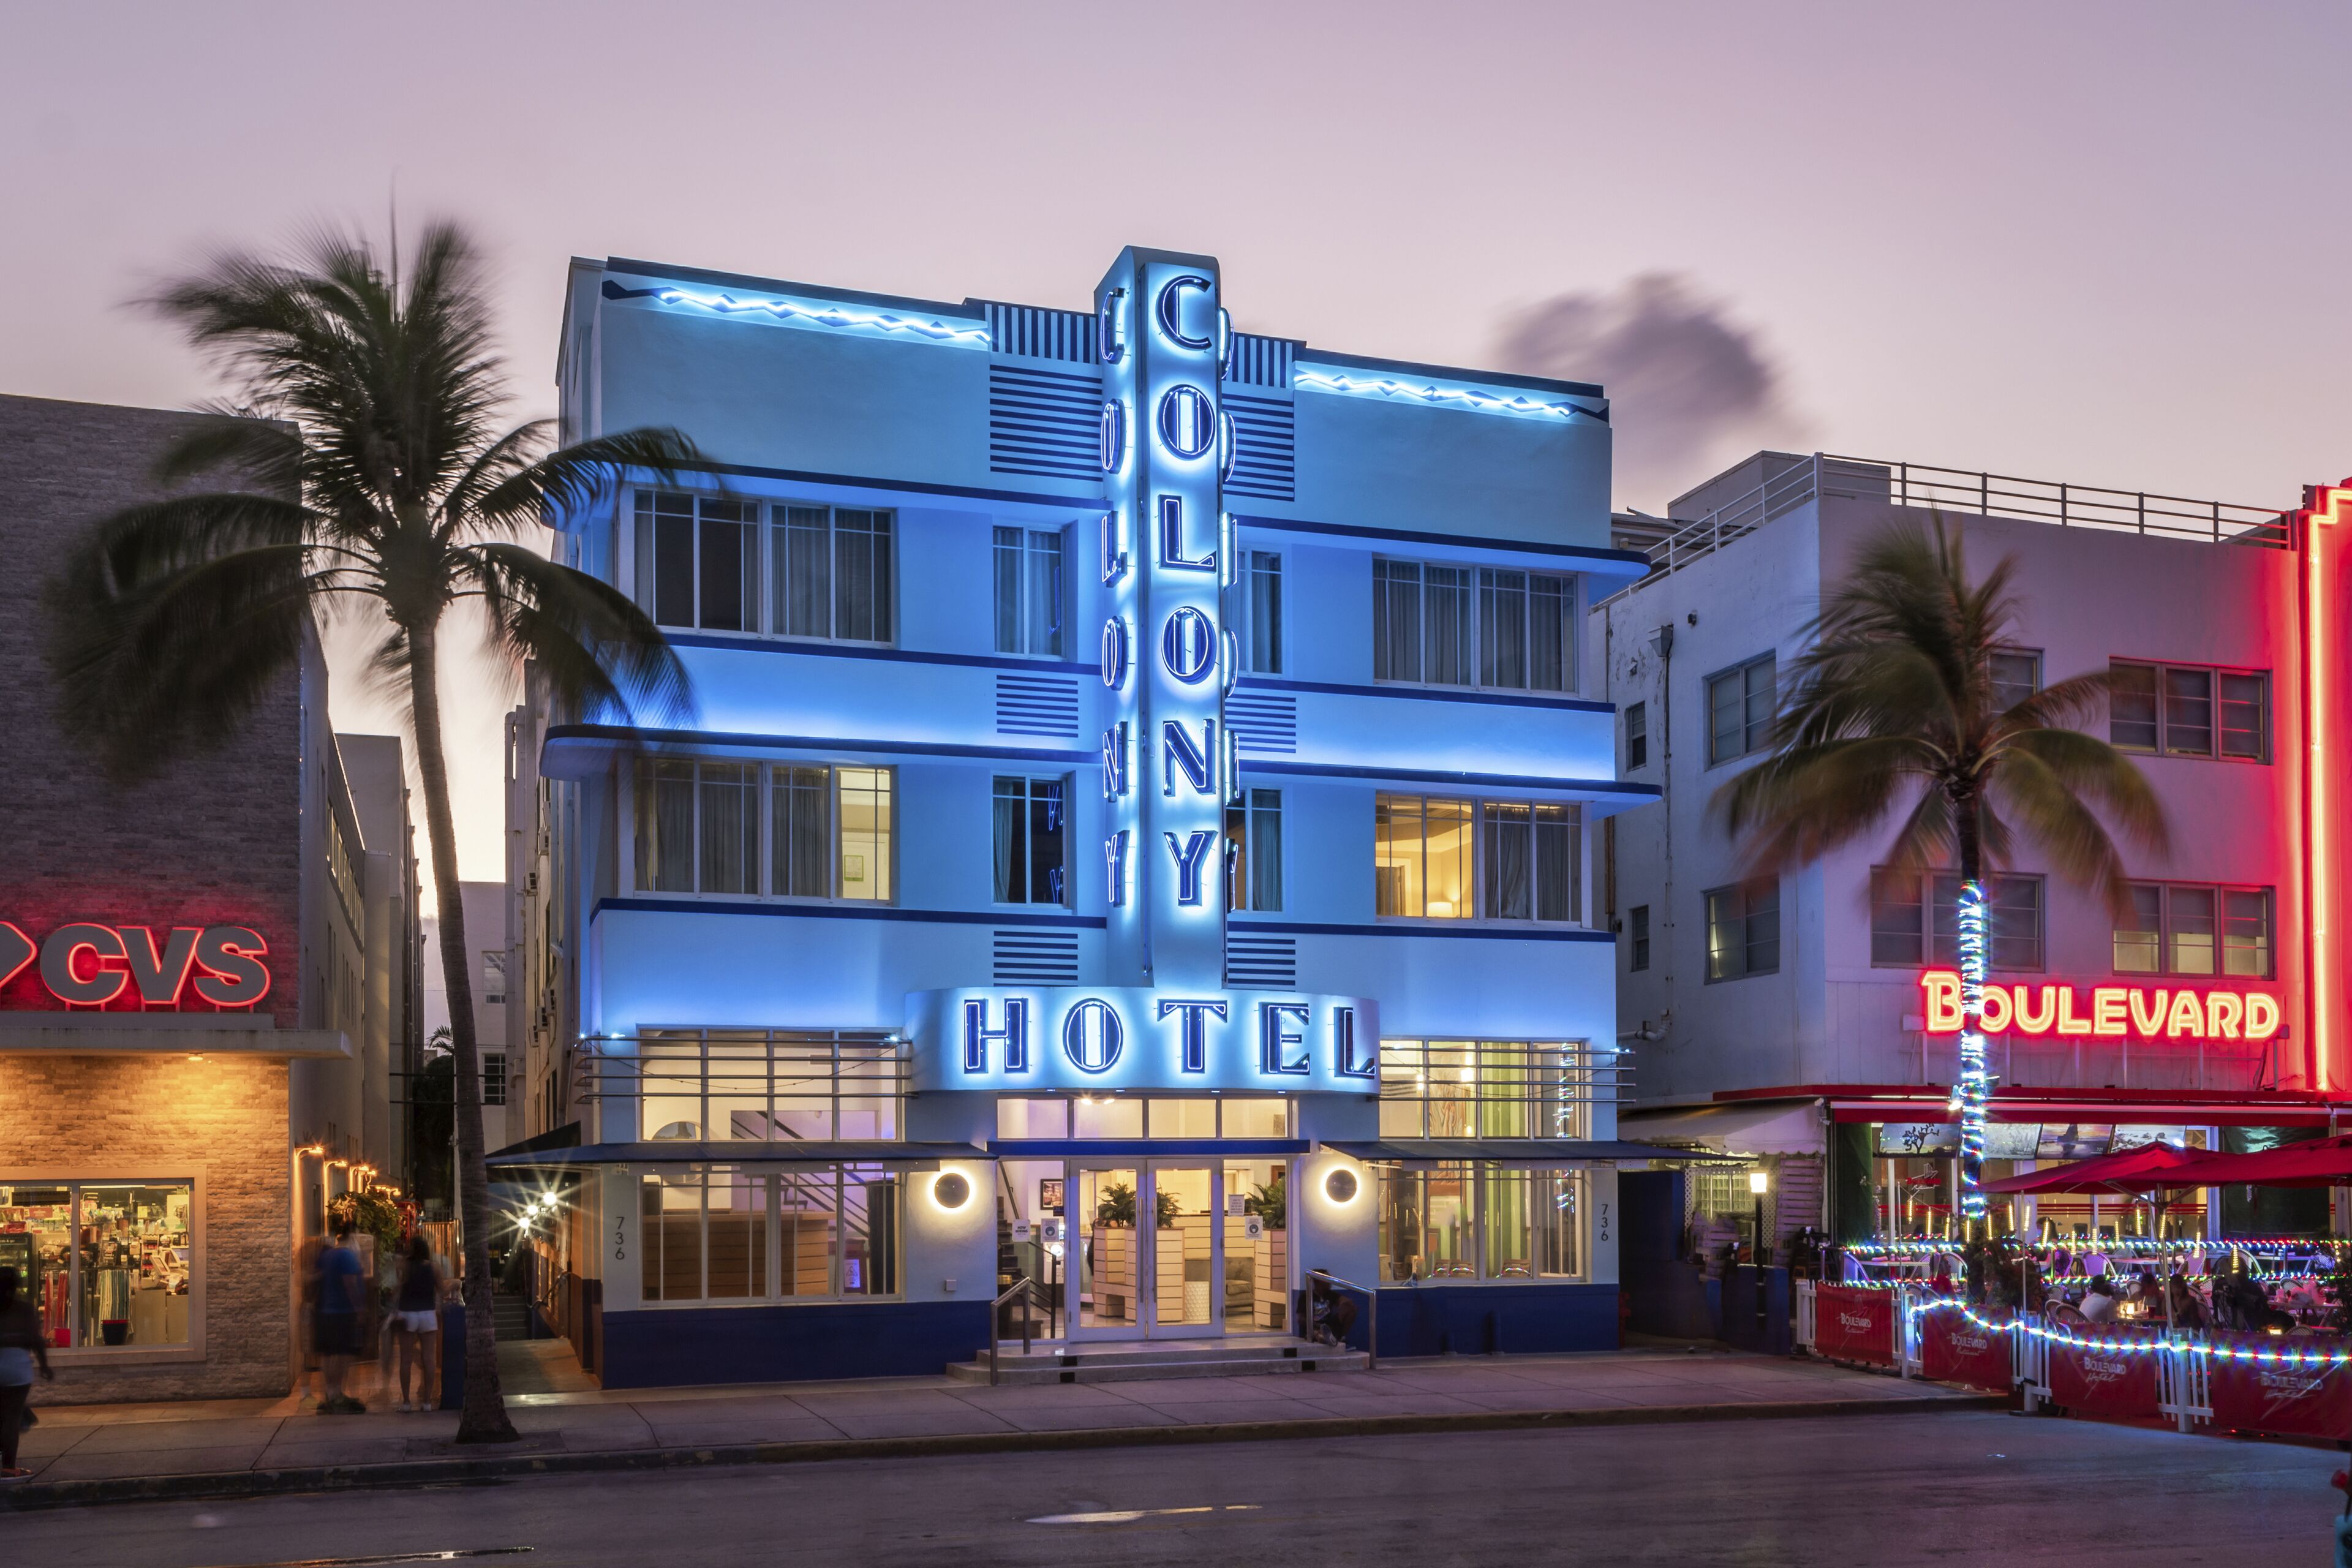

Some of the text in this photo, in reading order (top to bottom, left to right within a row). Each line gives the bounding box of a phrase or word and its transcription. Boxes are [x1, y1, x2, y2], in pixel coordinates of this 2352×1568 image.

[1156, 274, 1219, 908] COLONY
[40, 922, 271, 1007] CVS
[1921, 970, 2280, 1039] BOULEVARD
[963, 997, 1376, 1080] HOTEL
[615, 1216, 625, 1260] 736
[1600, 1204, 1609, 1242] 736
[1841, 1313, 1872, 1329] BOULEVARD
[1951, 1332, 1988, 1349] BOULEVARD
[2084, 1357, 2127, 1375] BOULEVARD
